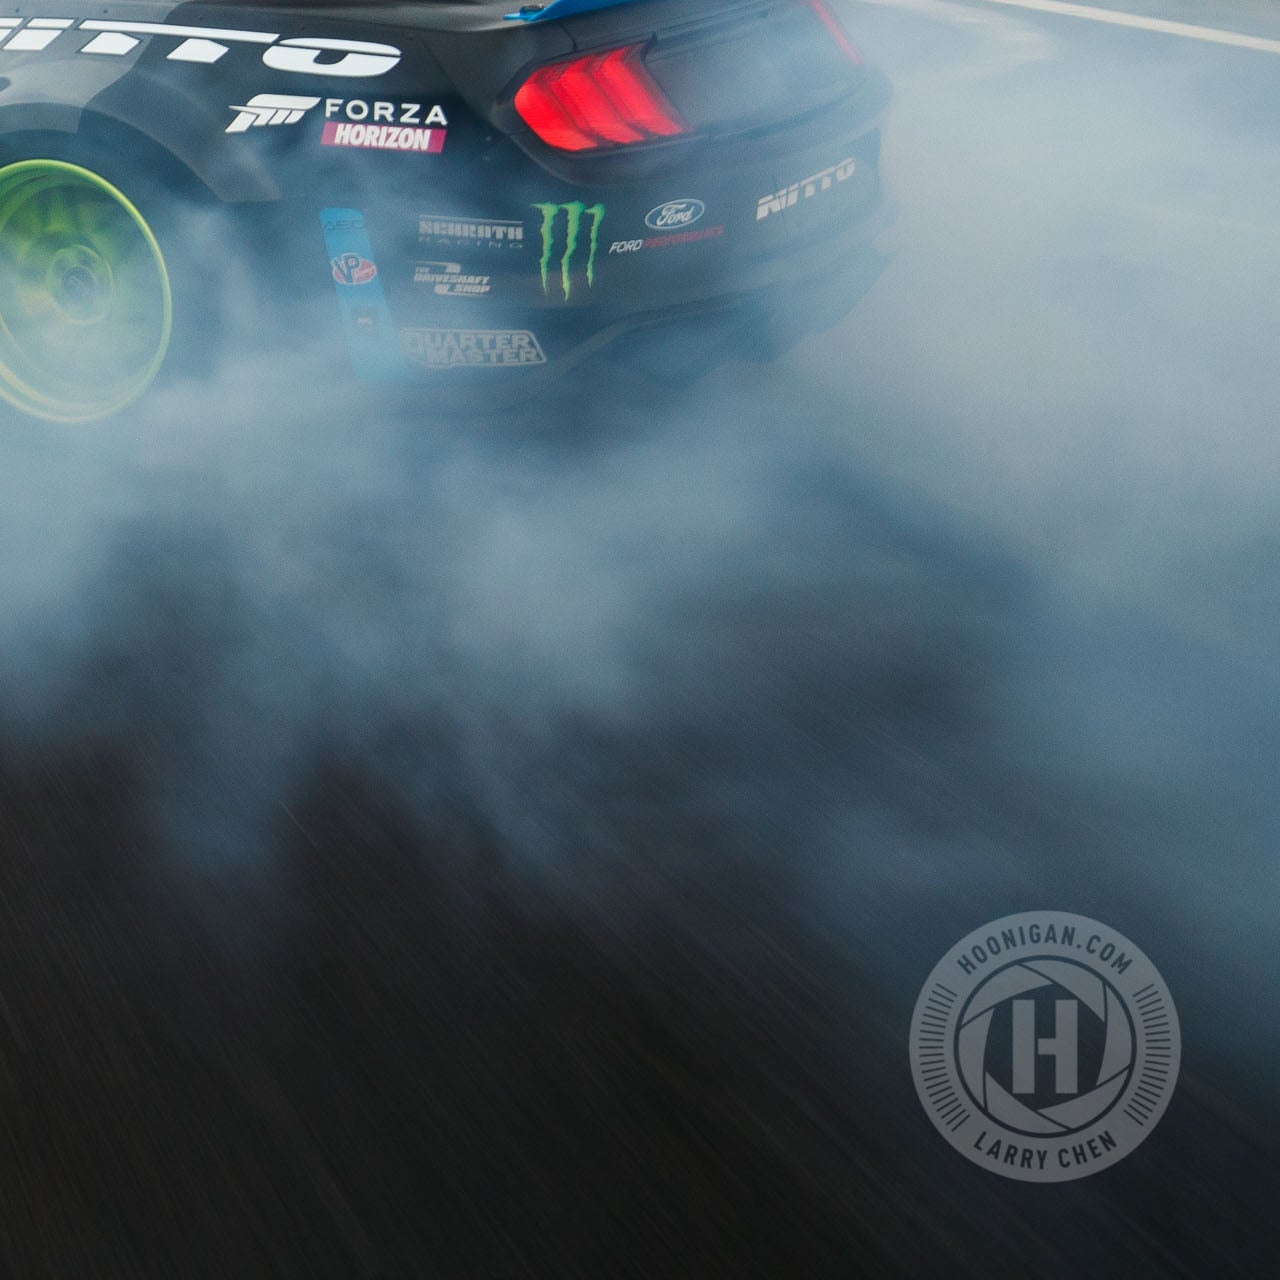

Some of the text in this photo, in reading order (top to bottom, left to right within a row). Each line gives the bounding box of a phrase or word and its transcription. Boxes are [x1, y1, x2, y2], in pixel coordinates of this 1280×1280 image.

[325, 98, 449, 126] FORZA
[334, 123, 432, 151] HORIZON
[656, 204, 696, 226] Ford
[608, 239, 644, 255] FORD
